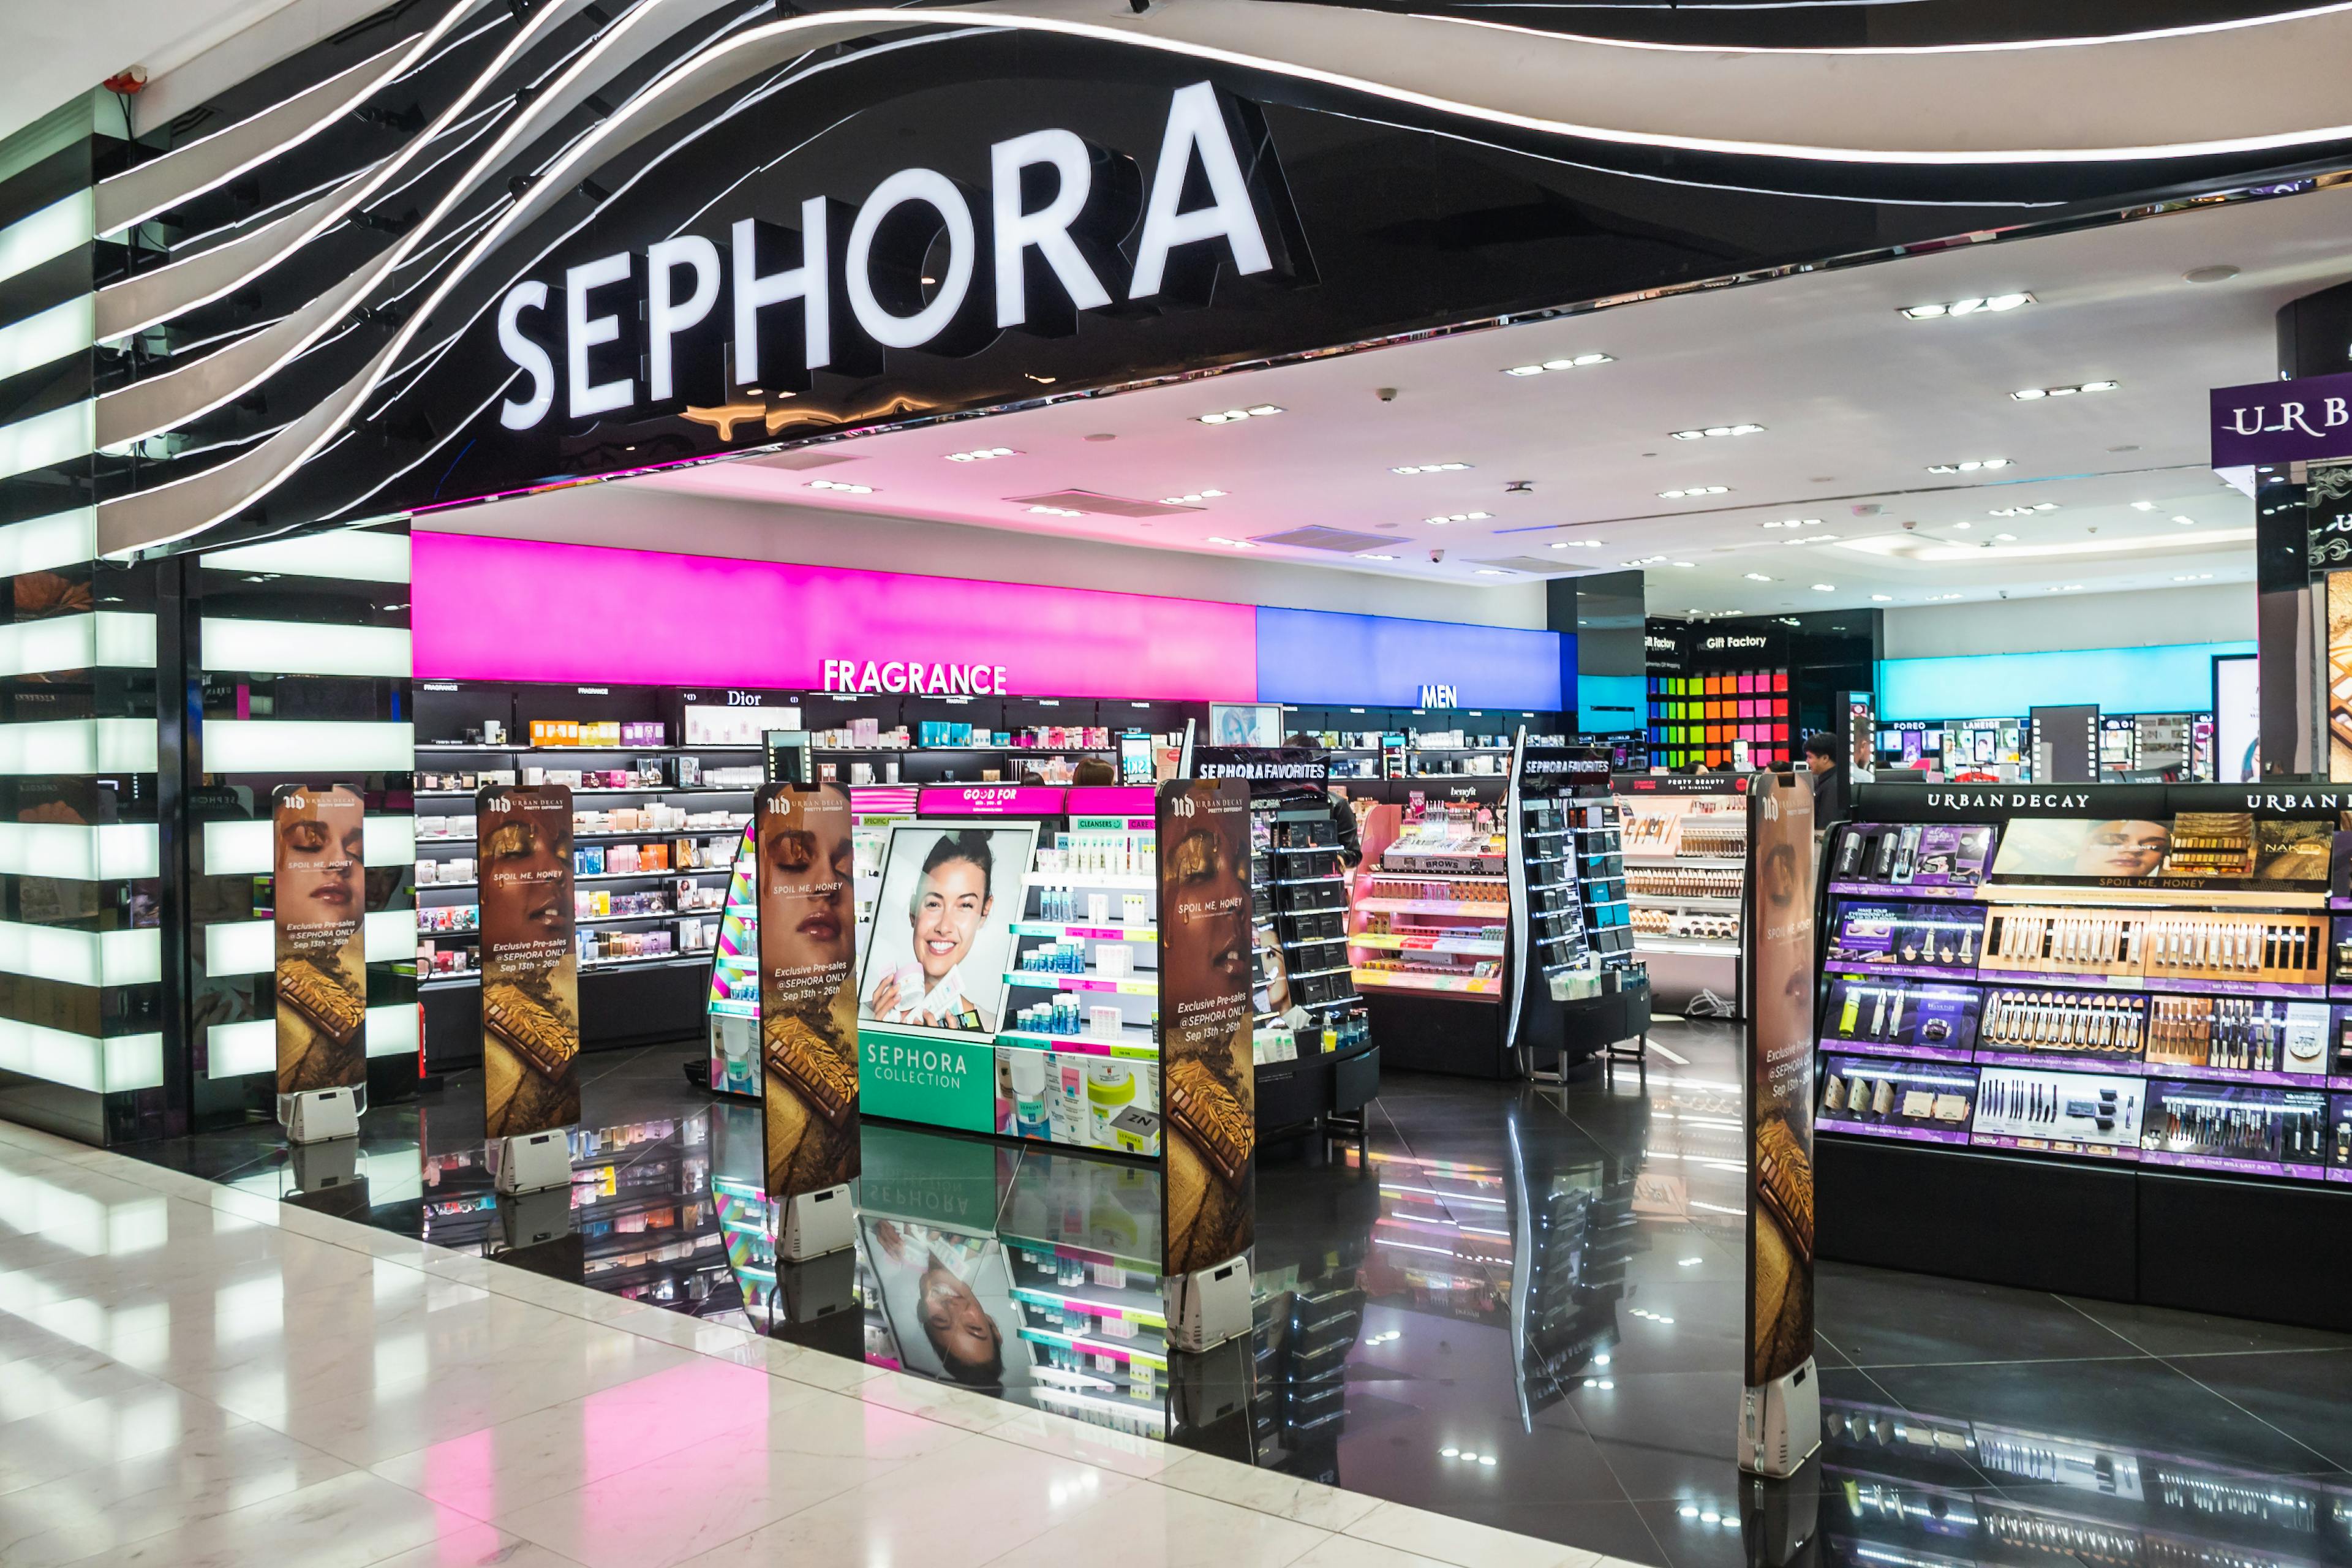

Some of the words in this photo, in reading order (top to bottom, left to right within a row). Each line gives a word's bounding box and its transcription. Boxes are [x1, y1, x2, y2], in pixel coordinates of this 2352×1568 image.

[497, 79, 1273, 432] SEPHORA
[1706, 637, 1725, 649] Gift
[1727, 636, 1766, 648] Factory
[824, 659, 1007, 695] FRAGRANCE
[727, 690, 761, 706] Dior
[1422, 684, 1458, 708] MEN
[1893, 722, 1926, 730] FOREO
[1962, 721, 2000, 729] LANEIGE
[1199, 764, 1264, 780] SEPHORA
[1264, 763, 1325, 779] FAVORITES
[1525, 760, 1567, 774] SEPHORA
[997, 789, 1017, 800] FOR
[1450, 786, 1477, 797] benefit
[1196, 800, 1221, 810] URBAN
[1927, 794, 2005, 810] URBAN
[2012, 794, 2089, 808] DECAY
[2247, 794, 2337, 812] URBAN
[2266, 843, 2322, 852] NAKED
[1425, 859, 1459, 869] BROWS
[815, 882, 843, 891] HONEY
[2099, 878, 2132, 886] SPOIL
[2163, 878, 2206, 888] HONEY
[1178, 903, 1202, 914] SPOIL
[1219, 897, 1243, 909] HONEY
[287, 921, 323, 931] Exclusive
[325, 919, 356, 929] Pre-sales
[288, 930, 334, 940] @SEPHORA
[336, 928, 355, 937] ONLY
[293, 941, 308, 949] Sep
[333, 937, 349, 946] 26th
[493, 942, 531, 952] Exclusive
[533, 938, 567, 948] Pre-sales
[495, 952, 543, 963] @SEPHORA
[545, 948, 567, 957] ONLY
[500, 964, 516, 973] Sep
[519, 962, 535, 970] 13th
[541, 959, 560, 968] 26th
[774, 965, 812, 977] Exclusive
[813, 961, 847, 973] Pre-sales
[777, 976, 824, 991] @SEPHORA
[826, 973, 847, 983] ONLY
[782, 992, 799, 1001] Sep
[801, 989, 816, 999] 13th
[823, 986, 840, 996] 26th
[1178, 998, 1216, 1014] Exclusive
[1216, 991, 1246, 1007] Pre-sales
[1180, 1011, 1226, 1030] @SEPHORA
[1227, 1005, 1246, 1018] ONLY
[1185, 1031, 1202, 1042] Sep
[1204, 1026, 1219, 1039] 13th
[1225, 1020, 1241, 1034] 26th
[867, 1044, 967, 1075] SEPHORA
[1766, 1044, 1795, 1063] Exclusive
[1768, 1057, 1804, 1082] @SEPHORA
[875, 1066, 960, 1090] COLLECTION
[1772, 1084, 1786, 1098] Sep
[1787, 1076, 1799, 1093] 13th
[1118, 1133, 1141, 1144] SEPHORA
